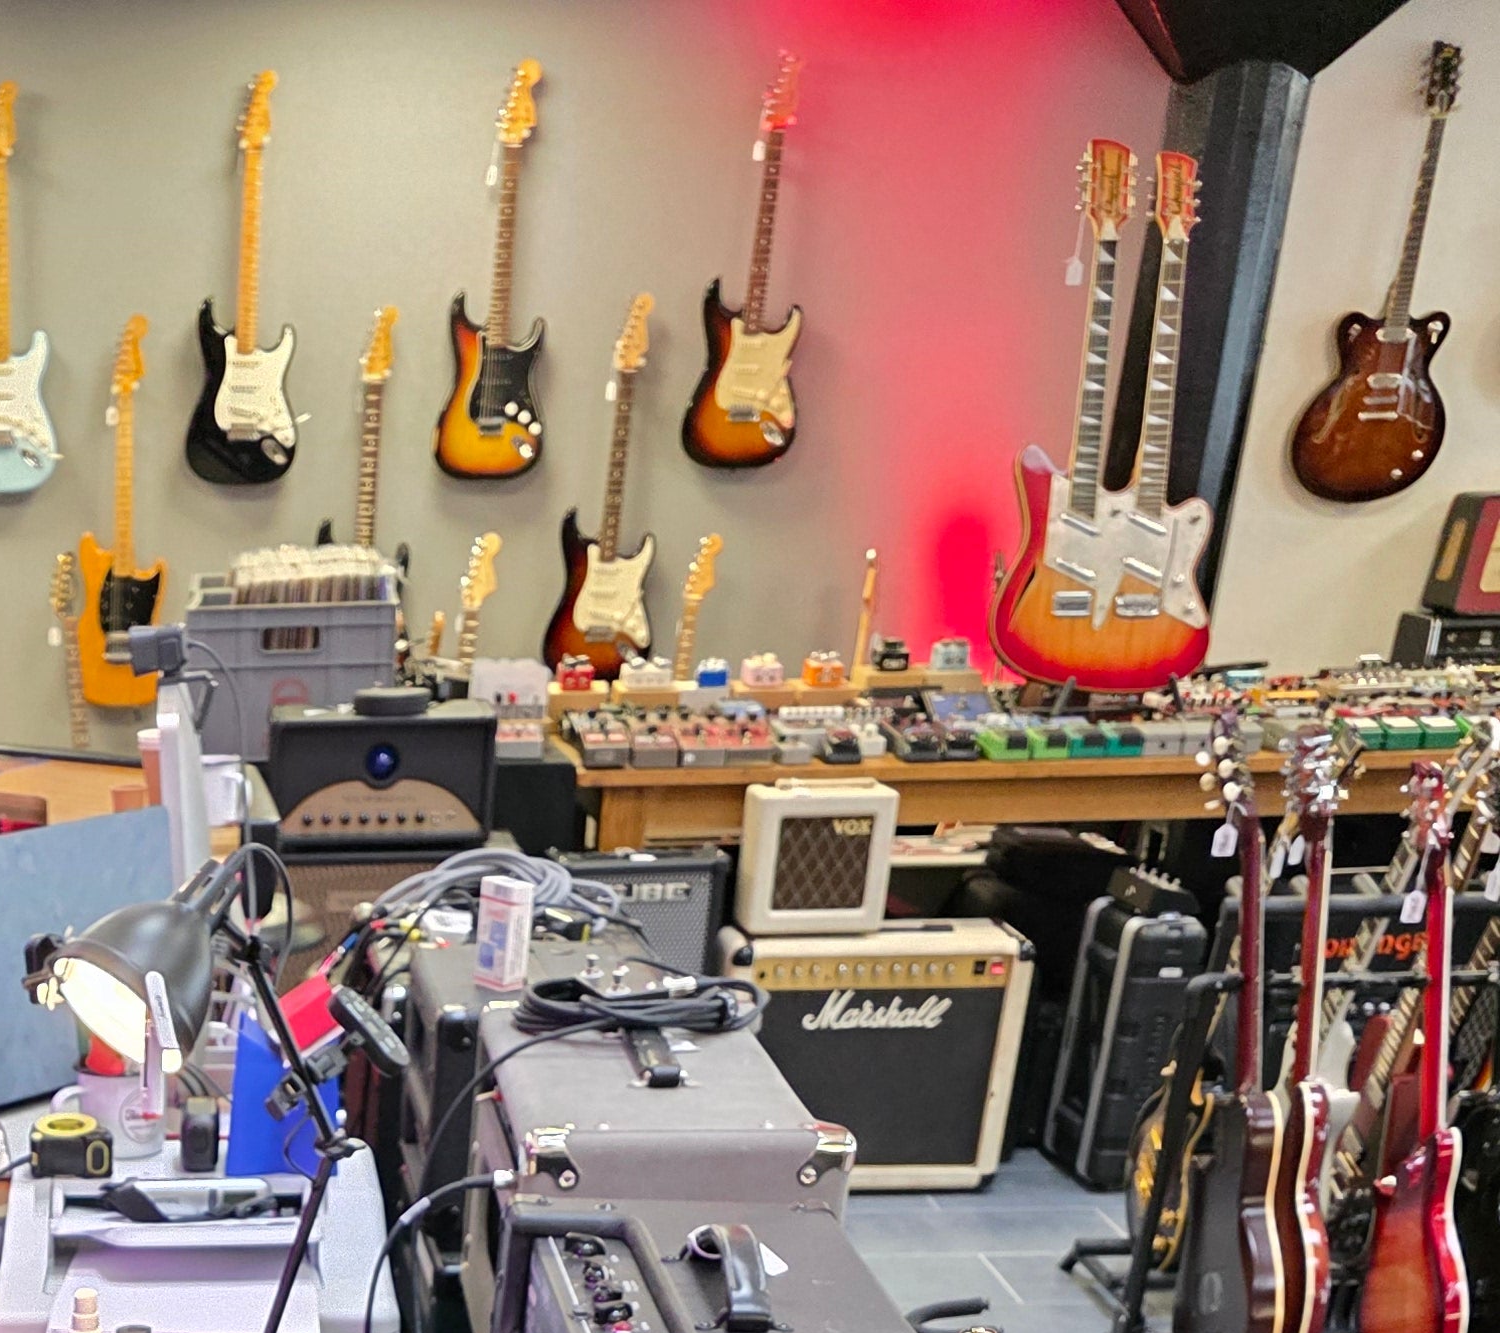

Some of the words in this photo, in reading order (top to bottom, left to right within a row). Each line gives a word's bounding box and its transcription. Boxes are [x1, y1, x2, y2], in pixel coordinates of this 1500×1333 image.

[832, 818, 872, 837] VOX
[596, 882, 692, 903] UBE
[802, 988, 953, 1031] Marshall
